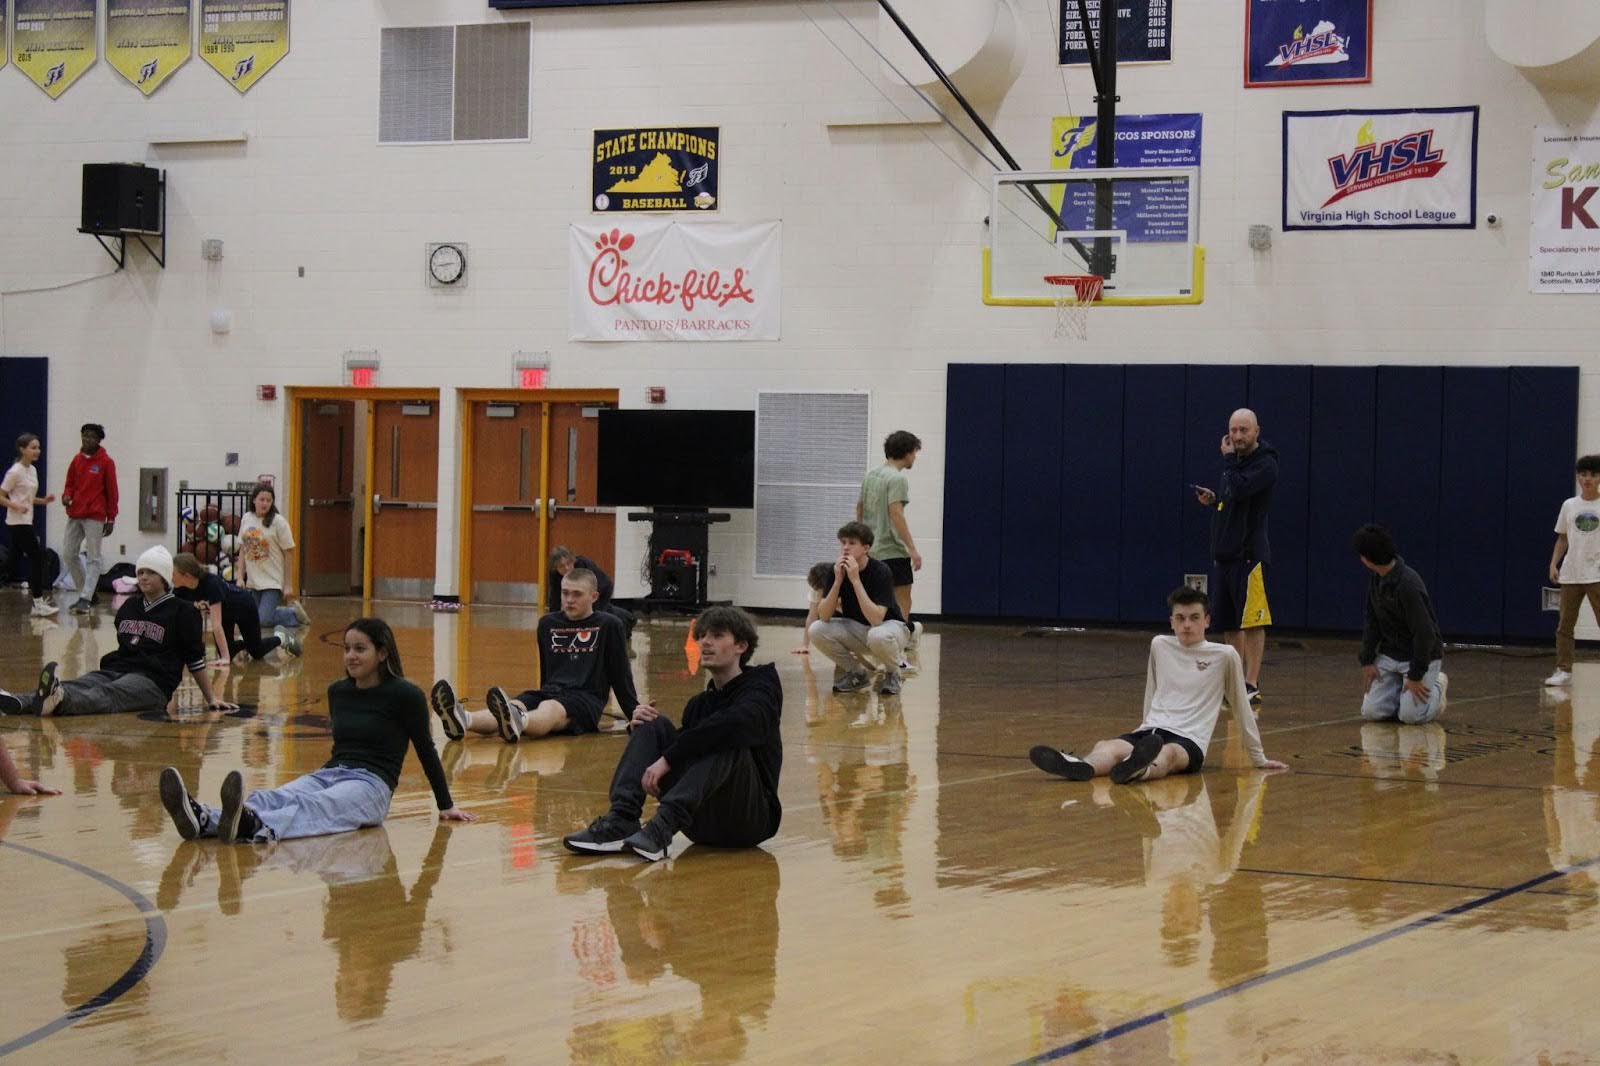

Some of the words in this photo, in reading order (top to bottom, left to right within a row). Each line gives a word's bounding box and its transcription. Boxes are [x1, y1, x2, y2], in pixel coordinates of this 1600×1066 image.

[1148, 7, 1166, 17] 2015
[1148, 17, 1166, 27] 2015
[1147, 28, 1166, 38] 2016
[1147, 38, 1166, 48] 2018
[1279, 32, 1339, 62] VHSL
[1141, 130, 1196, 140] SPONSORS
[597, 133, 636, 163] STATE
[639, 131, 716, 161] CHAMPIONS
[1327, 129, 1444, 190] VHSL
[1346, 181, 1373, 194] SERVING
[1373, 174, 1395, 185] YOUTH
[1395, 169, 1413, 180] SINCE
[622, 198, 688, 209] BASEBALL
[1300, 211, 1342, 223] Virginia
[1346, 210, 1370, 222] High
[1374, 209, 1412, 220] School
[1415, 208, 1456, 222] League
[1539, 246, 1579, 254] Specializing
[588, 245, 755, 311] Chick-fil-A
[614, 318, 751, 331] PANTOPS/BARRACKS
